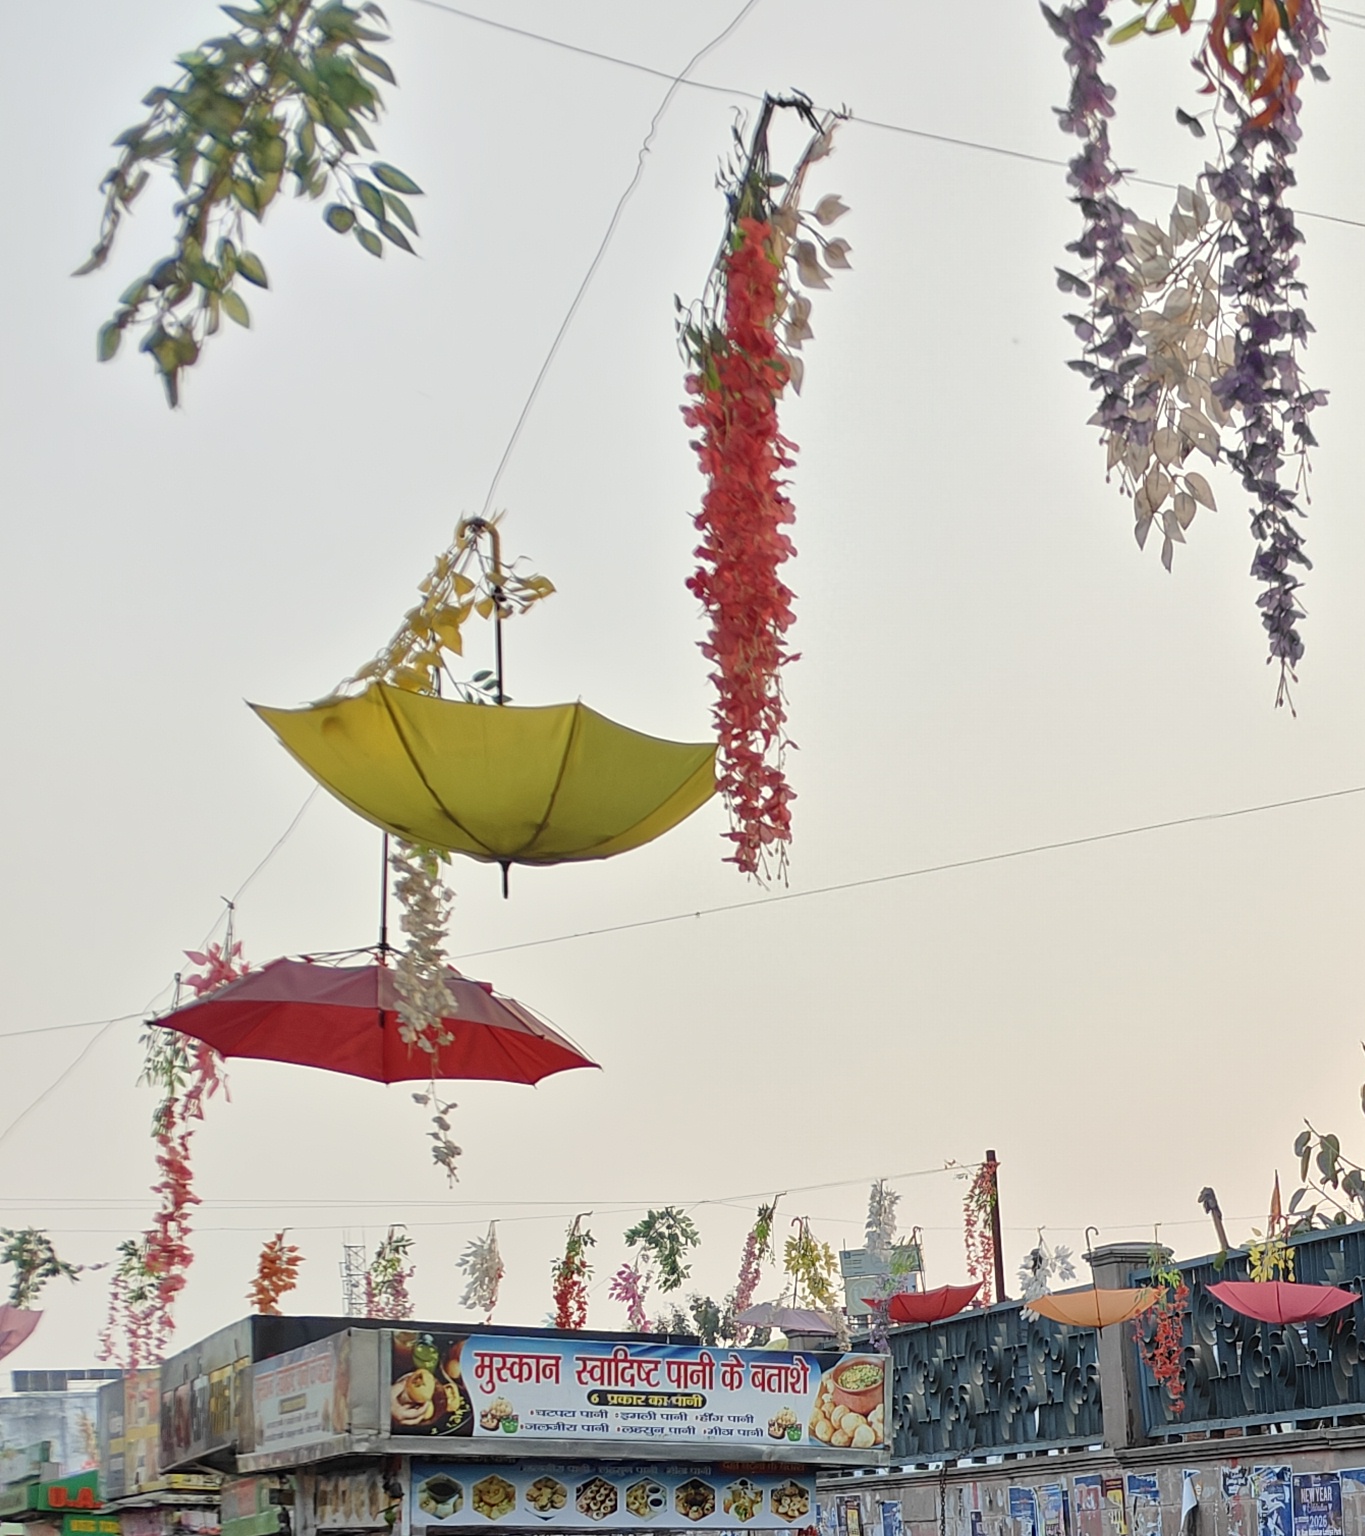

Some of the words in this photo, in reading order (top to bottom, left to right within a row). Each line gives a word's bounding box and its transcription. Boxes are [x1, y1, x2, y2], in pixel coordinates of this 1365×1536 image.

[474, 1352, 561, 1394] मुस्कान
[575, 1347, 661, 1388] स्वादिष्ट
[666, 1351, 715, 1390] पानी
[721, 1354, 745, 1391] के
[751, 1355, 809, 1394] बताशे
[607, 1393, 645, 1406] प्रकार
[649, 1395, 668, 1407] का
[671, 1394, 703, 1408] पानी
[579, 1408, 608, 1420] पानी
[660, 1410, 687, 1422] पानी
[727, 1412, 754, 1424] पानी
[581, 1421, 609, 1433] पानी
[668, 1424, 696, 1436] पानी
[737, 1426, 764, 1438] पानी
[1301, 1487, 1315, 1503] NEW
[1315, 1486, 1332, 1501] YEAR
[1309, 1514, 1328, 1528] 2026
